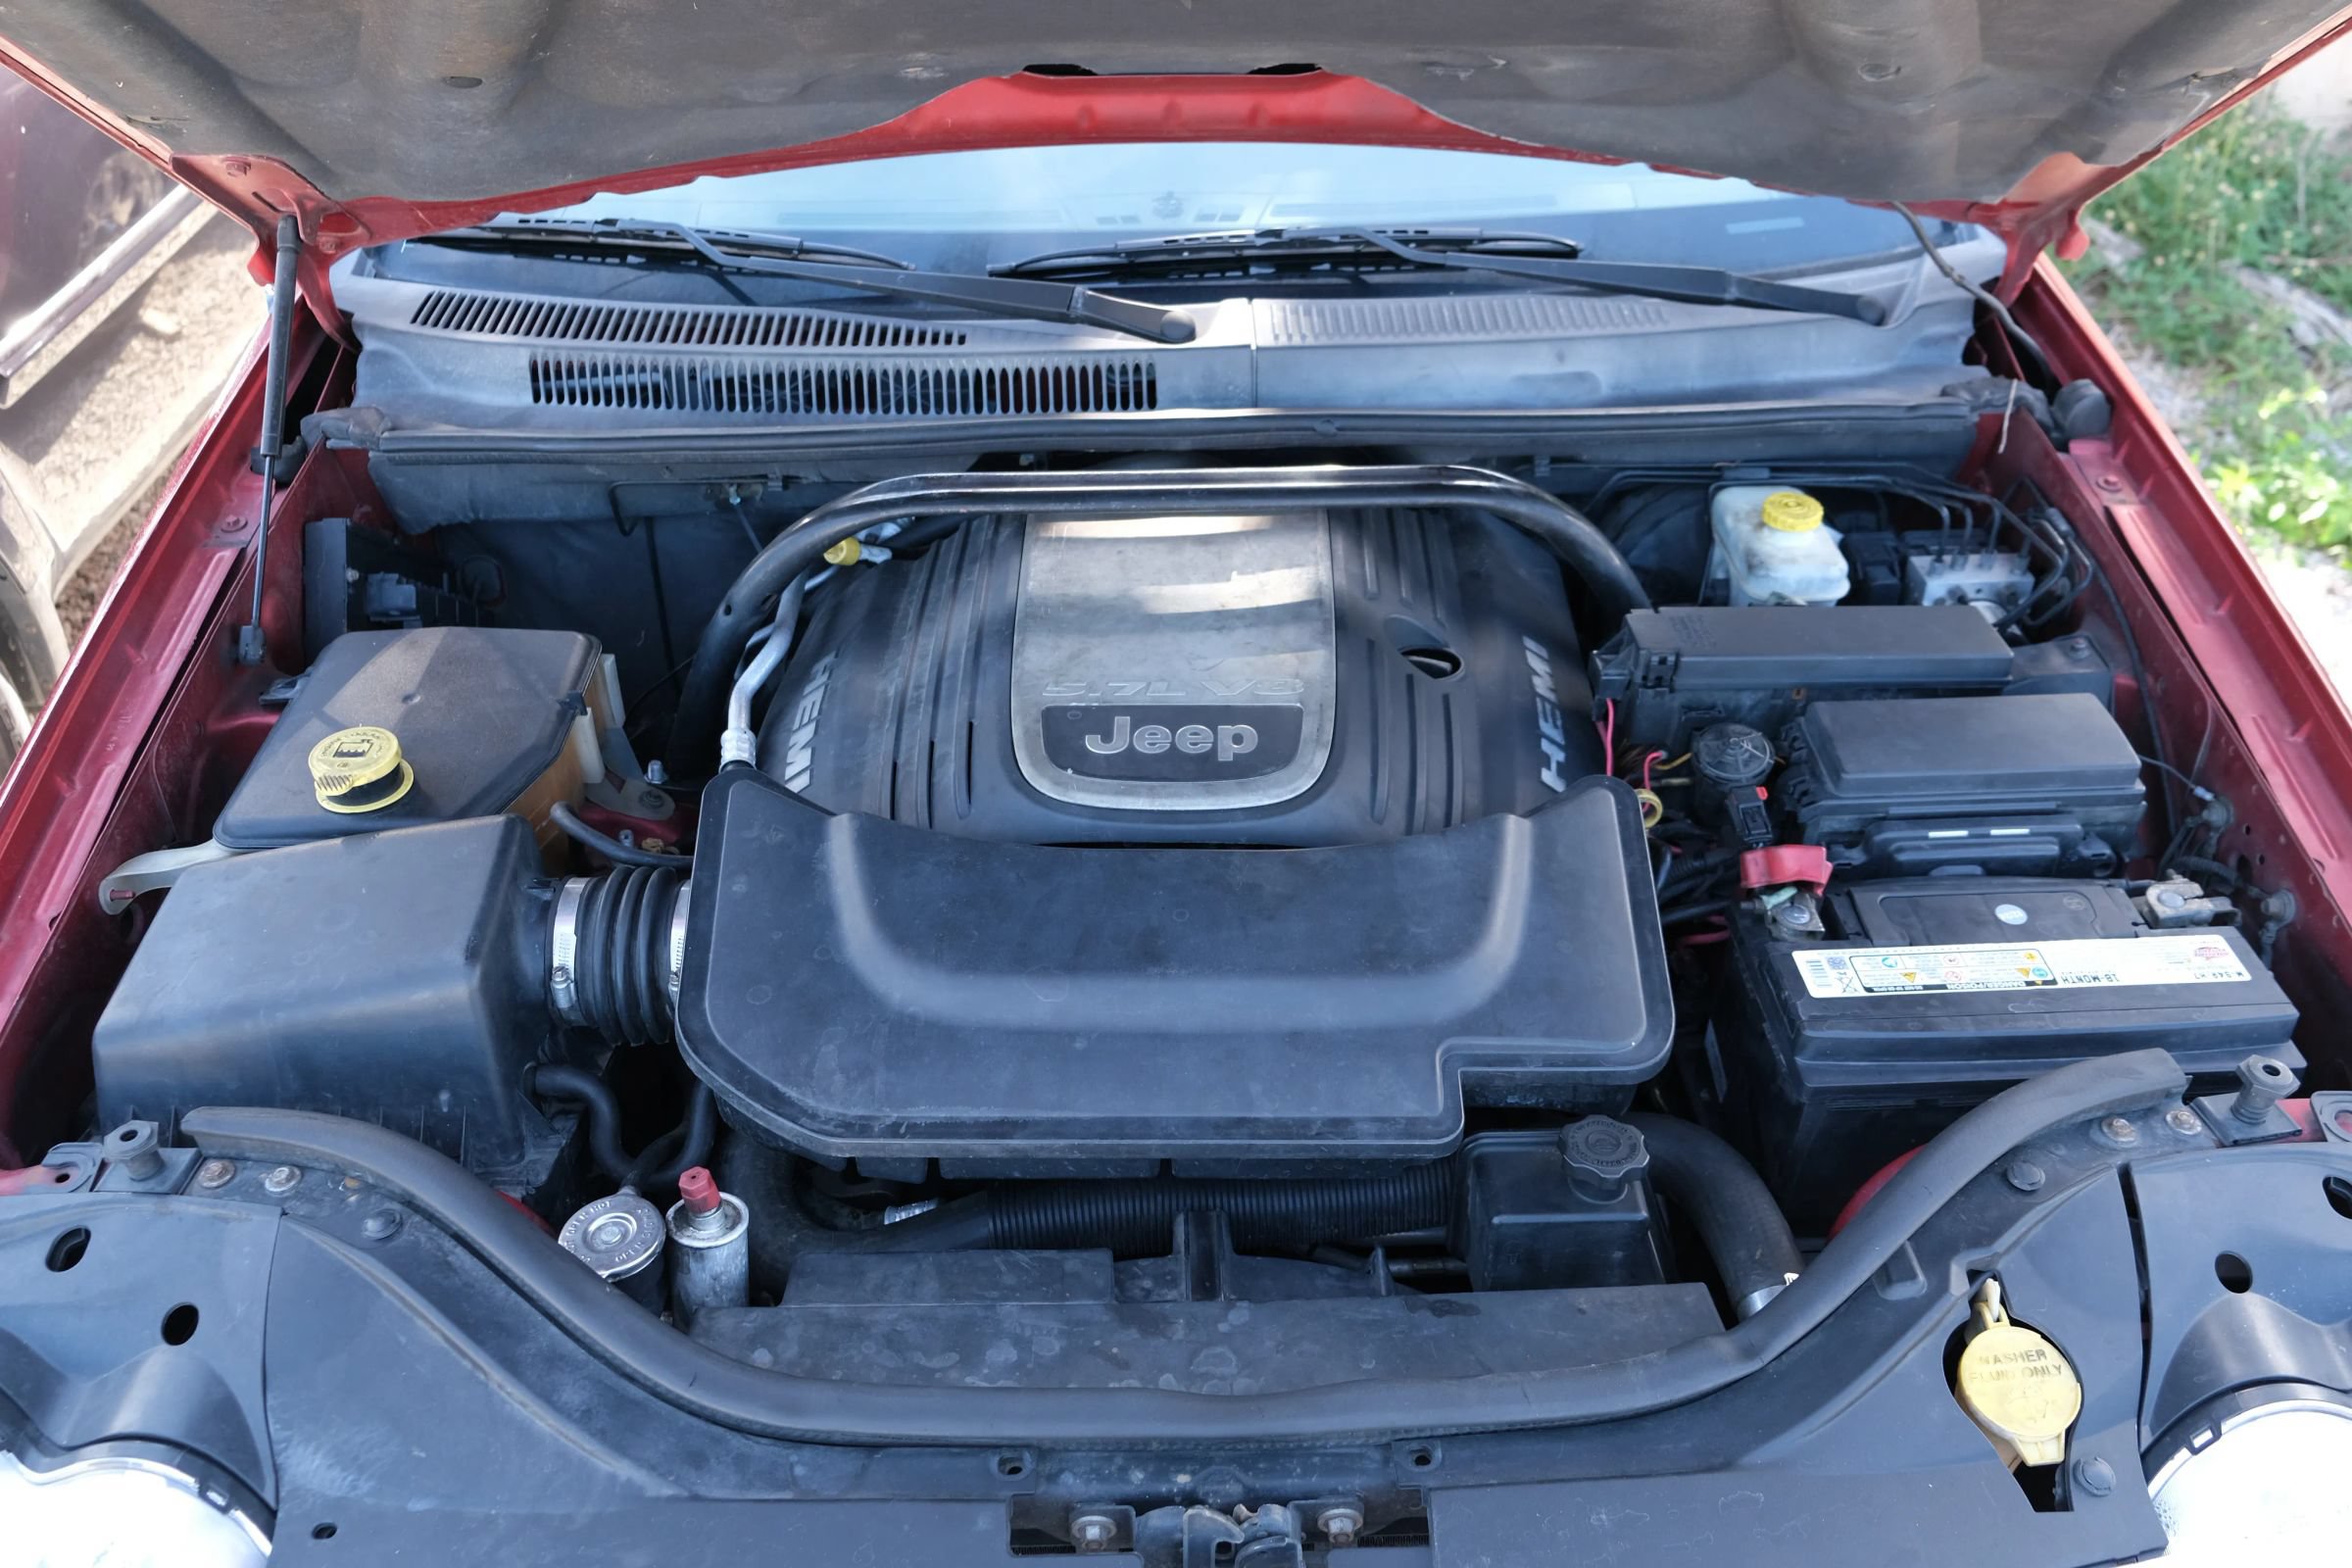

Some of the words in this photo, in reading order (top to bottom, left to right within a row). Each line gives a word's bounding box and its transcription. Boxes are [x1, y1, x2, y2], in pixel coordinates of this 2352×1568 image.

[1042, 680, 1186, 697] 5.7L
[1200, 678, 1305, 697] V8
[784, 650, 837, 794] HEMI
[1522, 635, 1567, 793] HEMI
[1085, 716, 1258, 761] Jeep
[1946, 980, 2027, 991] DANGER/POISON
[2060, 973, 2121, 985] 18-MONTH
[1979, 1348, 2047, 1365] WASHER
[2022, 1363, 2063, 1379] ONLY
